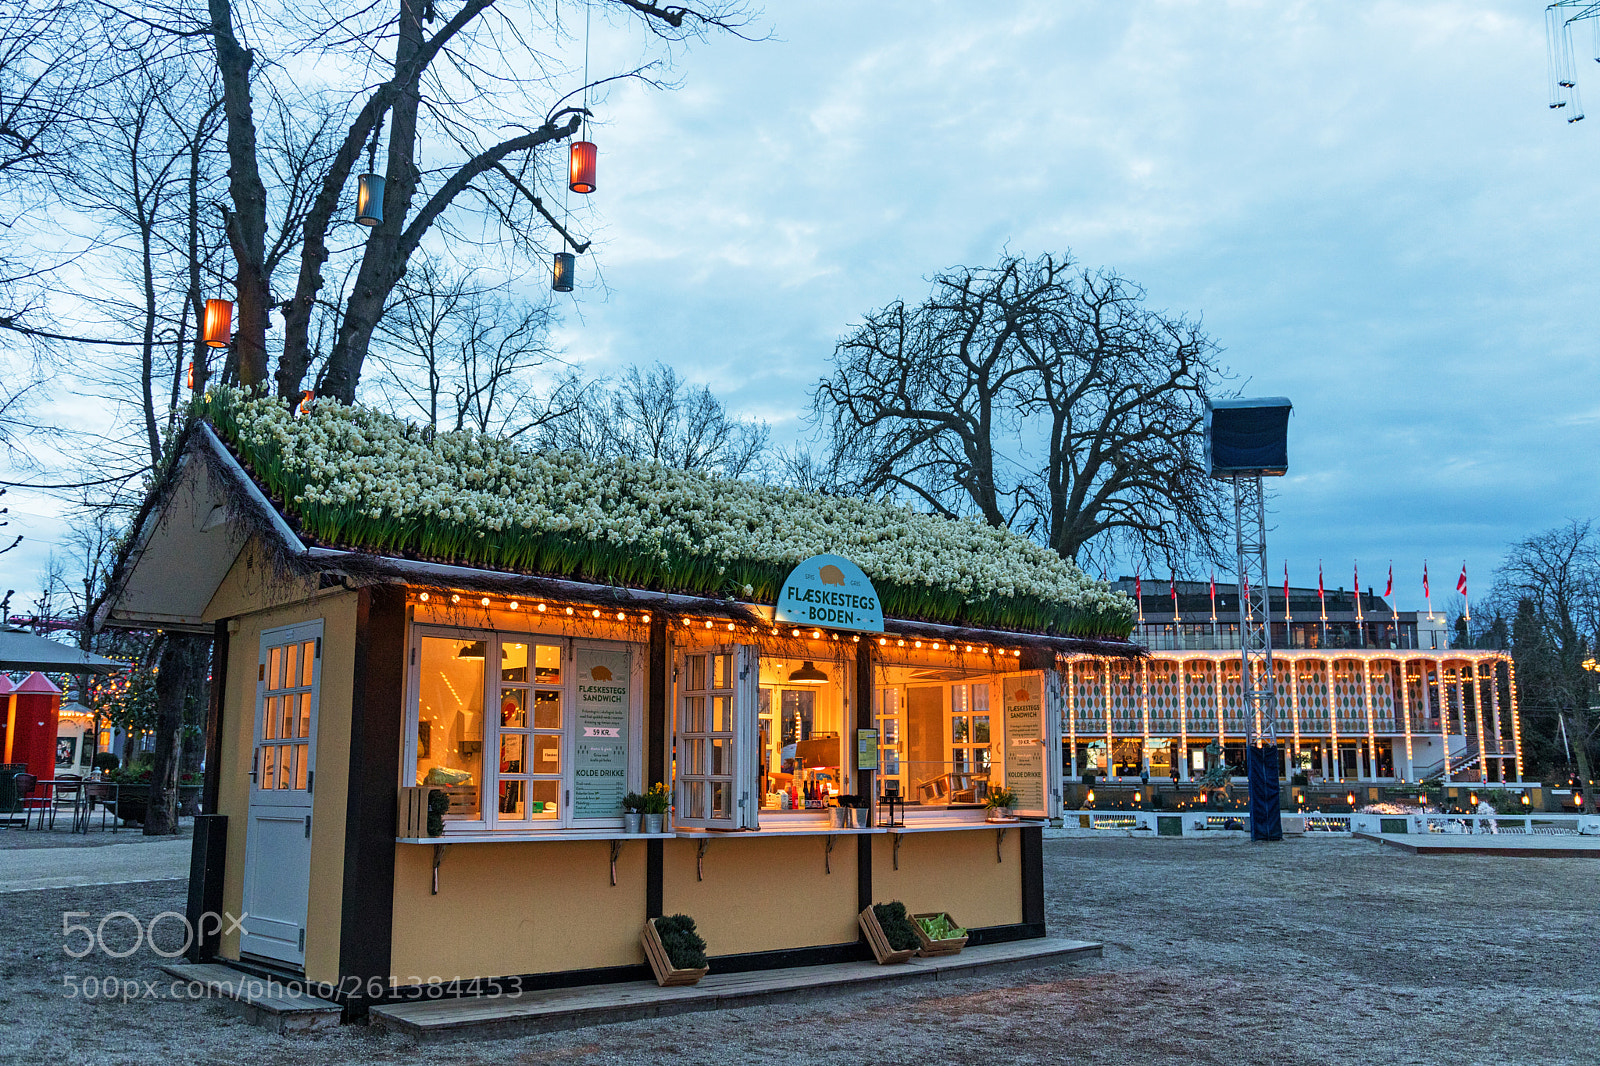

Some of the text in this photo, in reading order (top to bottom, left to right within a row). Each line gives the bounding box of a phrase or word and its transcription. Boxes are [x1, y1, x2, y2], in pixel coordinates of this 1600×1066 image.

[788, 586, 875, 610] FLÆSKESTEGS
[809, 606, 854, 624] BODEN
[579, 685, 626, 695] FLÆSKESTEGS
[583, 694, 622, 703] SANDWICH
[1008, 704, 1040, 712] FLÆSKESTEGS
[576, 769, 624, 777] KOLDE DRIKKE
